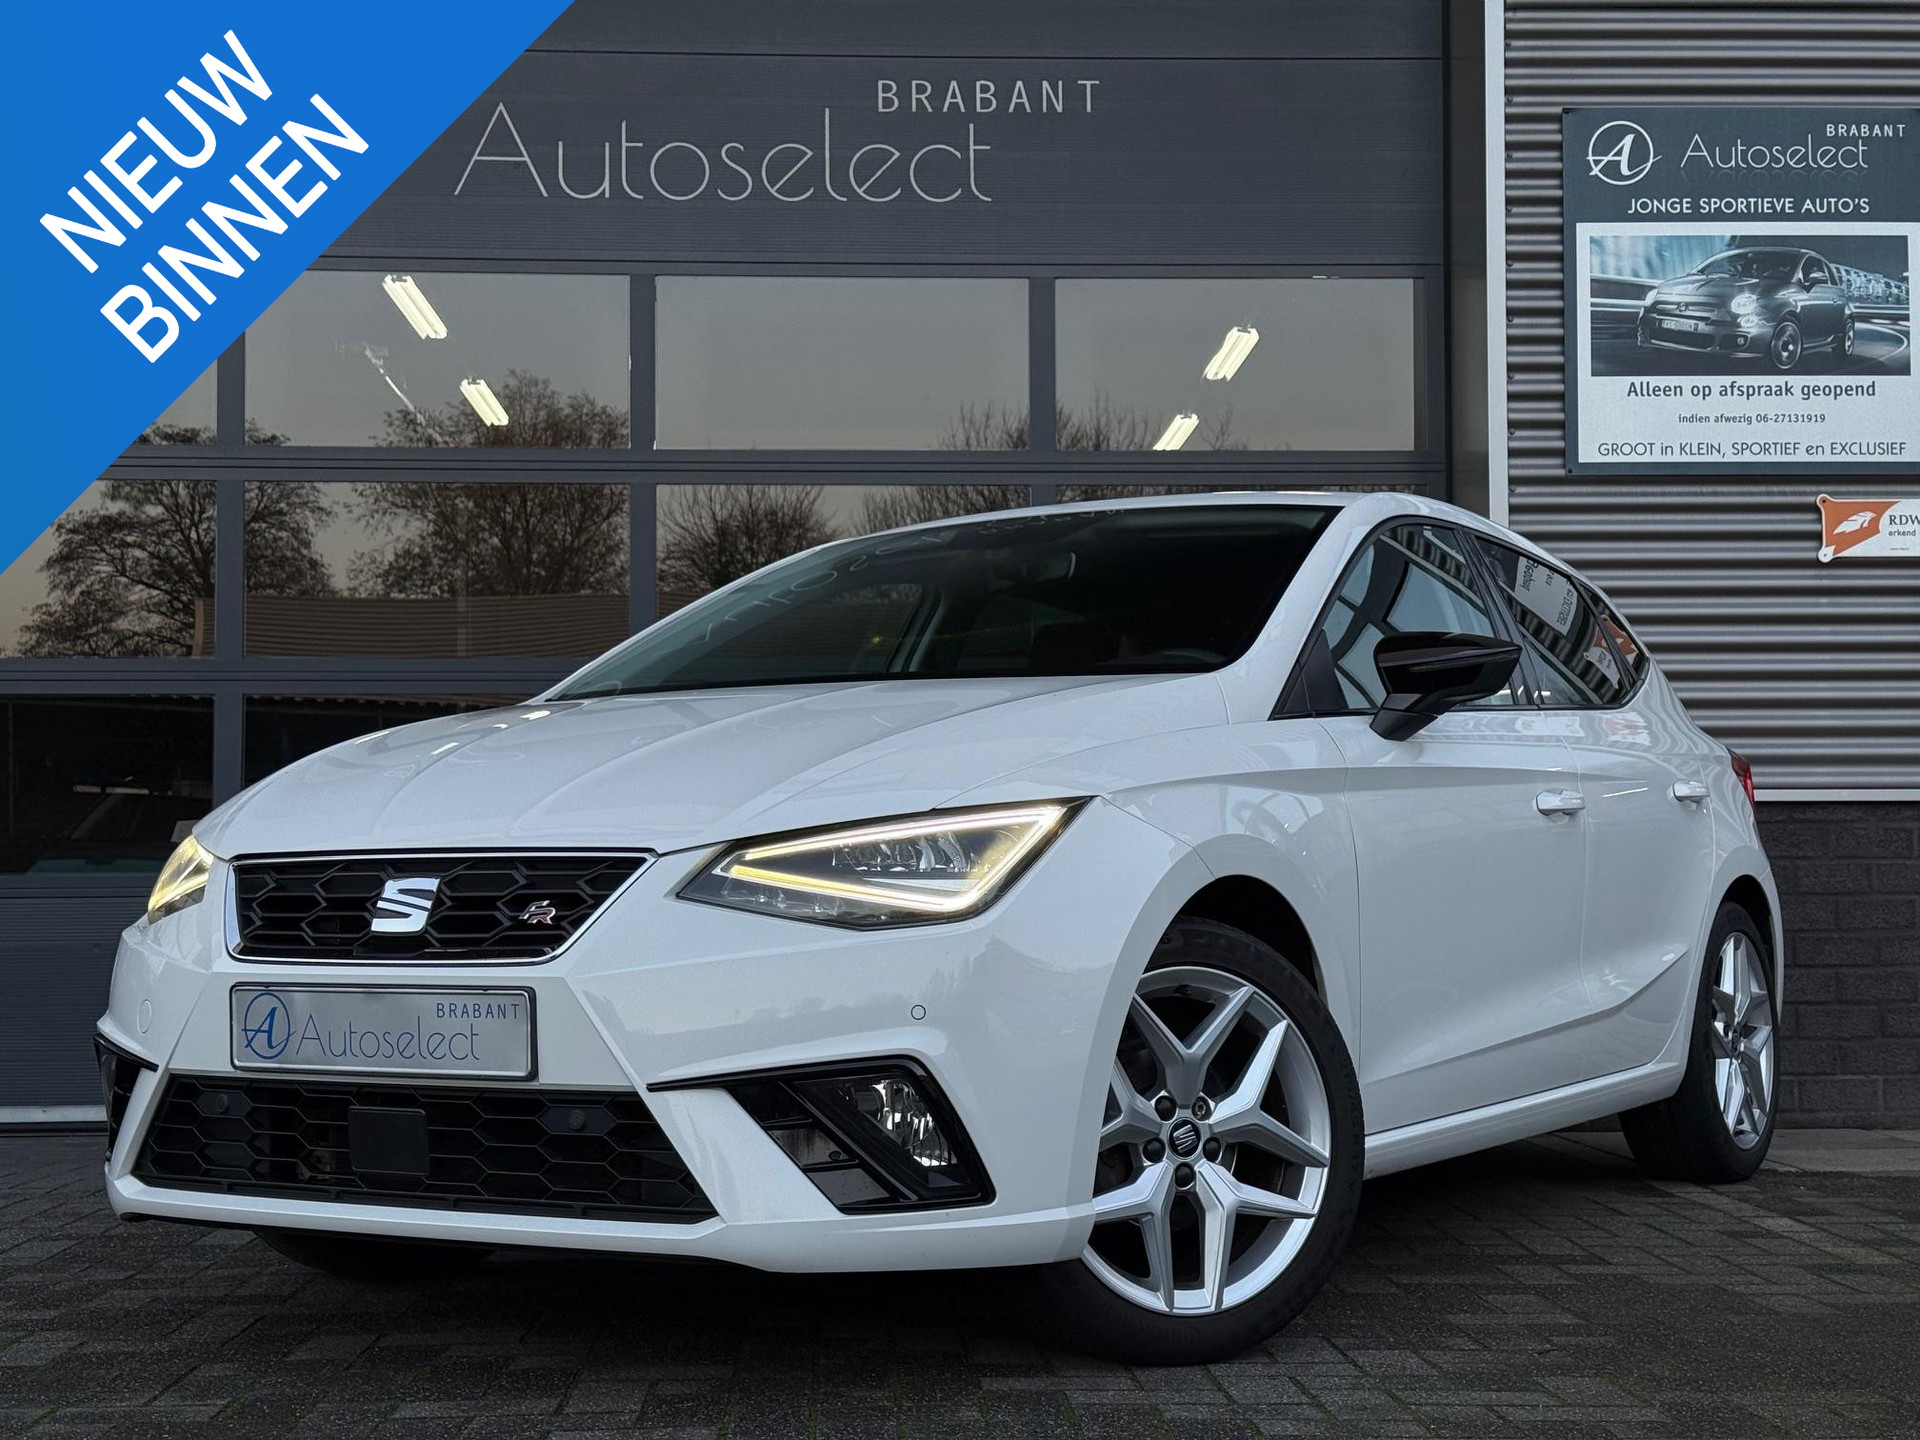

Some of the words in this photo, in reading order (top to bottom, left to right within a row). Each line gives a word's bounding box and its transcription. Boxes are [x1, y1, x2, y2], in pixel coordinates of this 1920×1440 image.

[877, 79, 1100, 113] BRABANT
[1826, 123, 1906, 138] BRABANT
[454, 102, 992, 203] Autoselect
[1680, 133, 1869, 169] Autoselect
[1627, 197, 1692, 214] JONGE
[1699, 197, 1795, 214] SPORTIEVE
[1801, 197, 1870, 214] AUTO'S
[1626, 380, 1683, 398] Alleen
[1690, 384, 1712, 401] op
[1718, 380, 1795, 401] afspraak
[1800, 380, 1876, 401] geopend
[1678, 413, 1711, 424] indien
[1713, 413, 1753, 426] afwezig
[1755, 413, 1826, 424] 06-27131919
[1597, 442, 1656, 457] GROOT
[1660, 442, 1674, 456] in
[1679, 442, 1726, 459] KLEIN,
[1731, 441, 1801, 456] SPORTIEF
[1805, 444, 1825, 456] en
[1830, 441, 1907, 456] EXCLUSIEF
[1888, 529, 1917, 537] erkend
[436, 1002, 520, 1020] BRABANT
[296, 1013, 481, 1061] Autoselect
